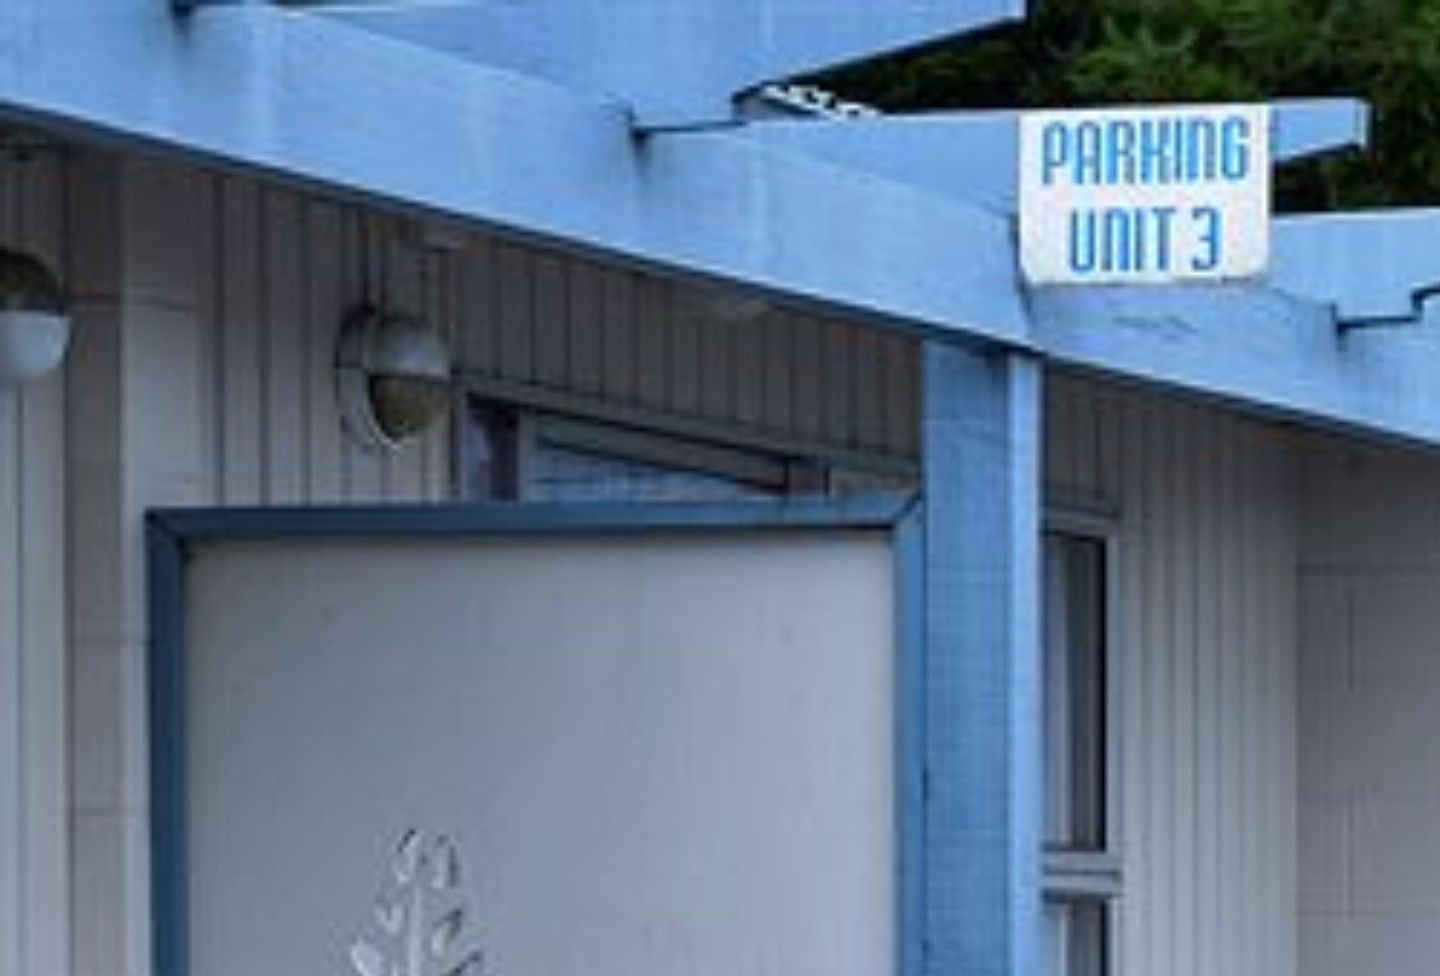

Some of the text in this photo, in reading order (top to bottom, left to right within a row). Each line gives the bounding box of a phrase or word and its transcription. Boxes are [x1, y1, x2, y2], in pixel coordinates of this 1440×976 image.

[1042, 117, 1249, 185] PARKING
[1070, 207, 1221, 271] UNIT 3
